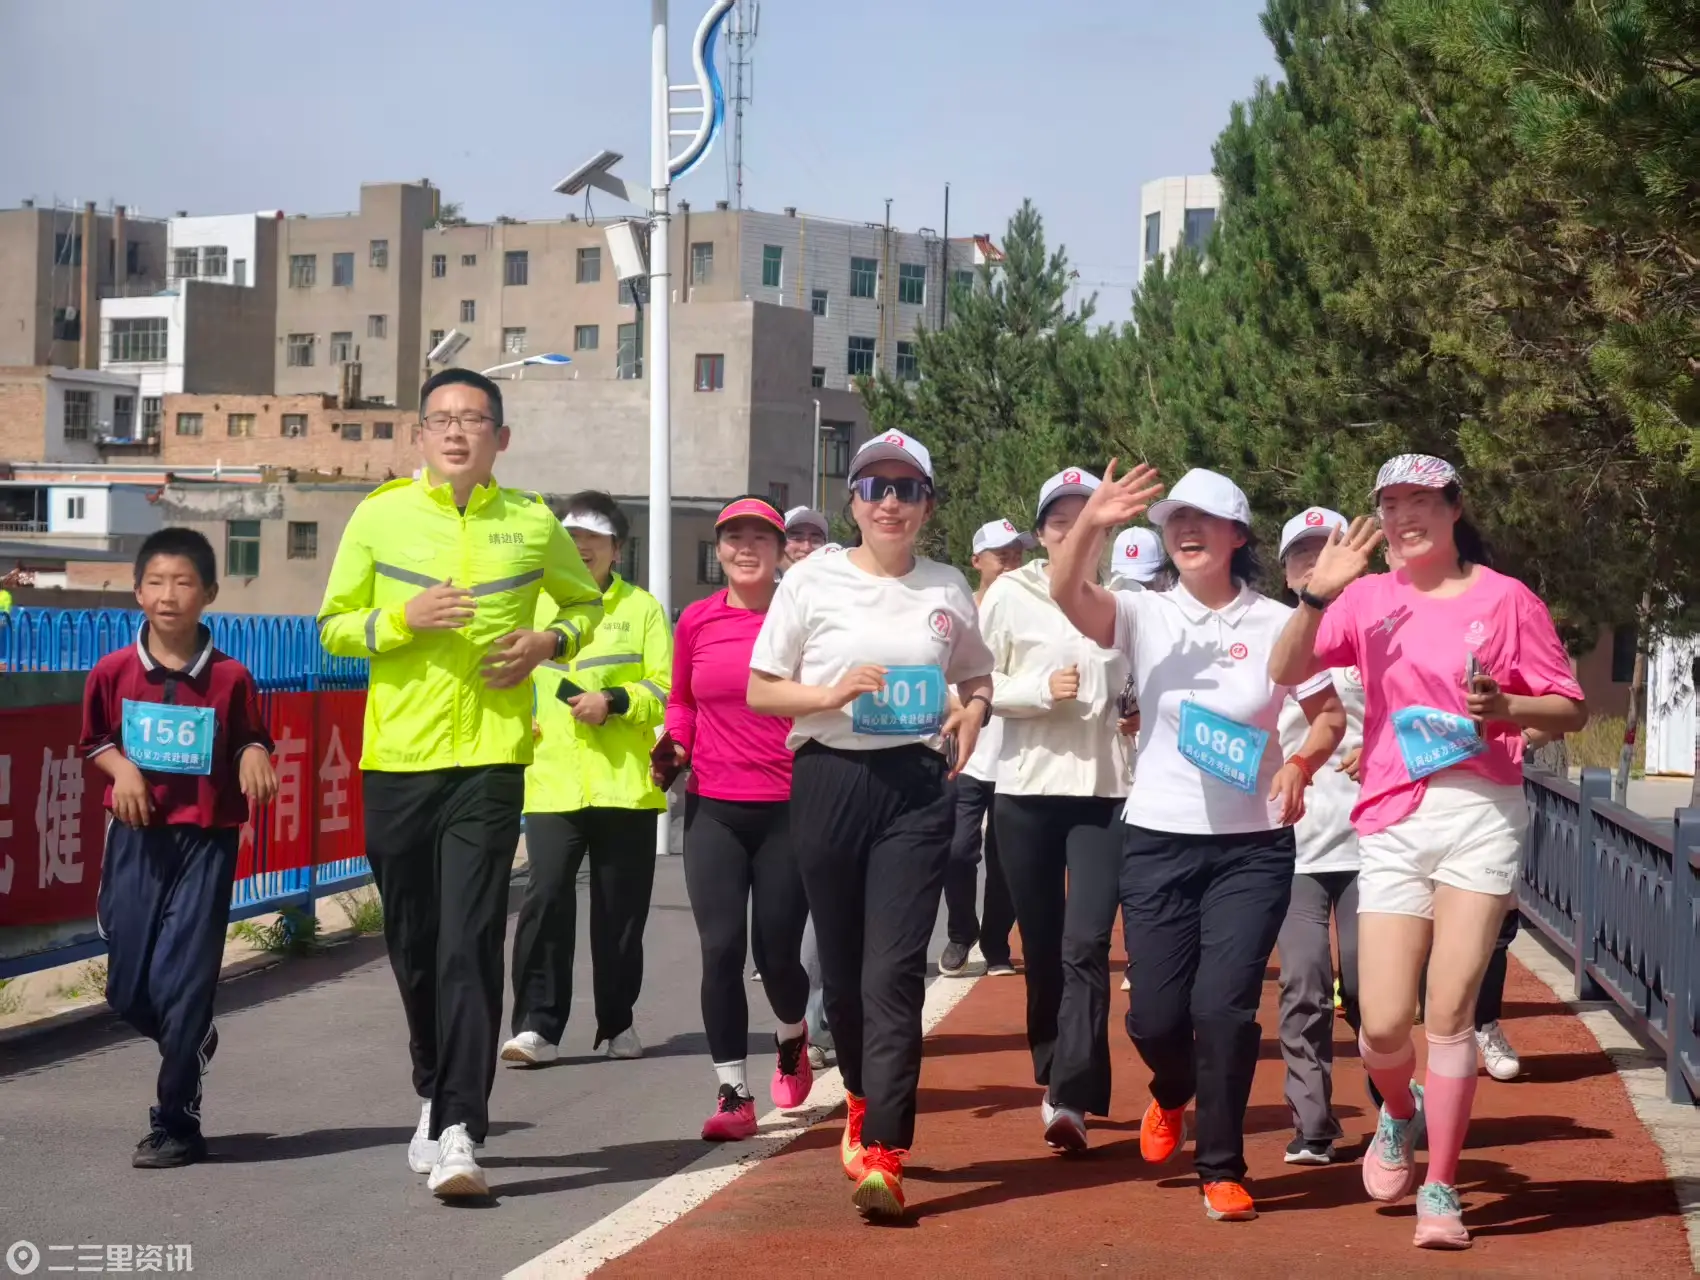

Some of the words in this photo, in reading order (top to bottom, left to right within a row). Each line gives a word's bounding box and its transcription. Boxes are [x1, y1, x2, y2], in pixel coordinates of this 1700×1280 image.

[488, 531, 525, 545] 靖边段
[139, 716, 197, 747] 156
[1195, 722, 1247, 763] 086
